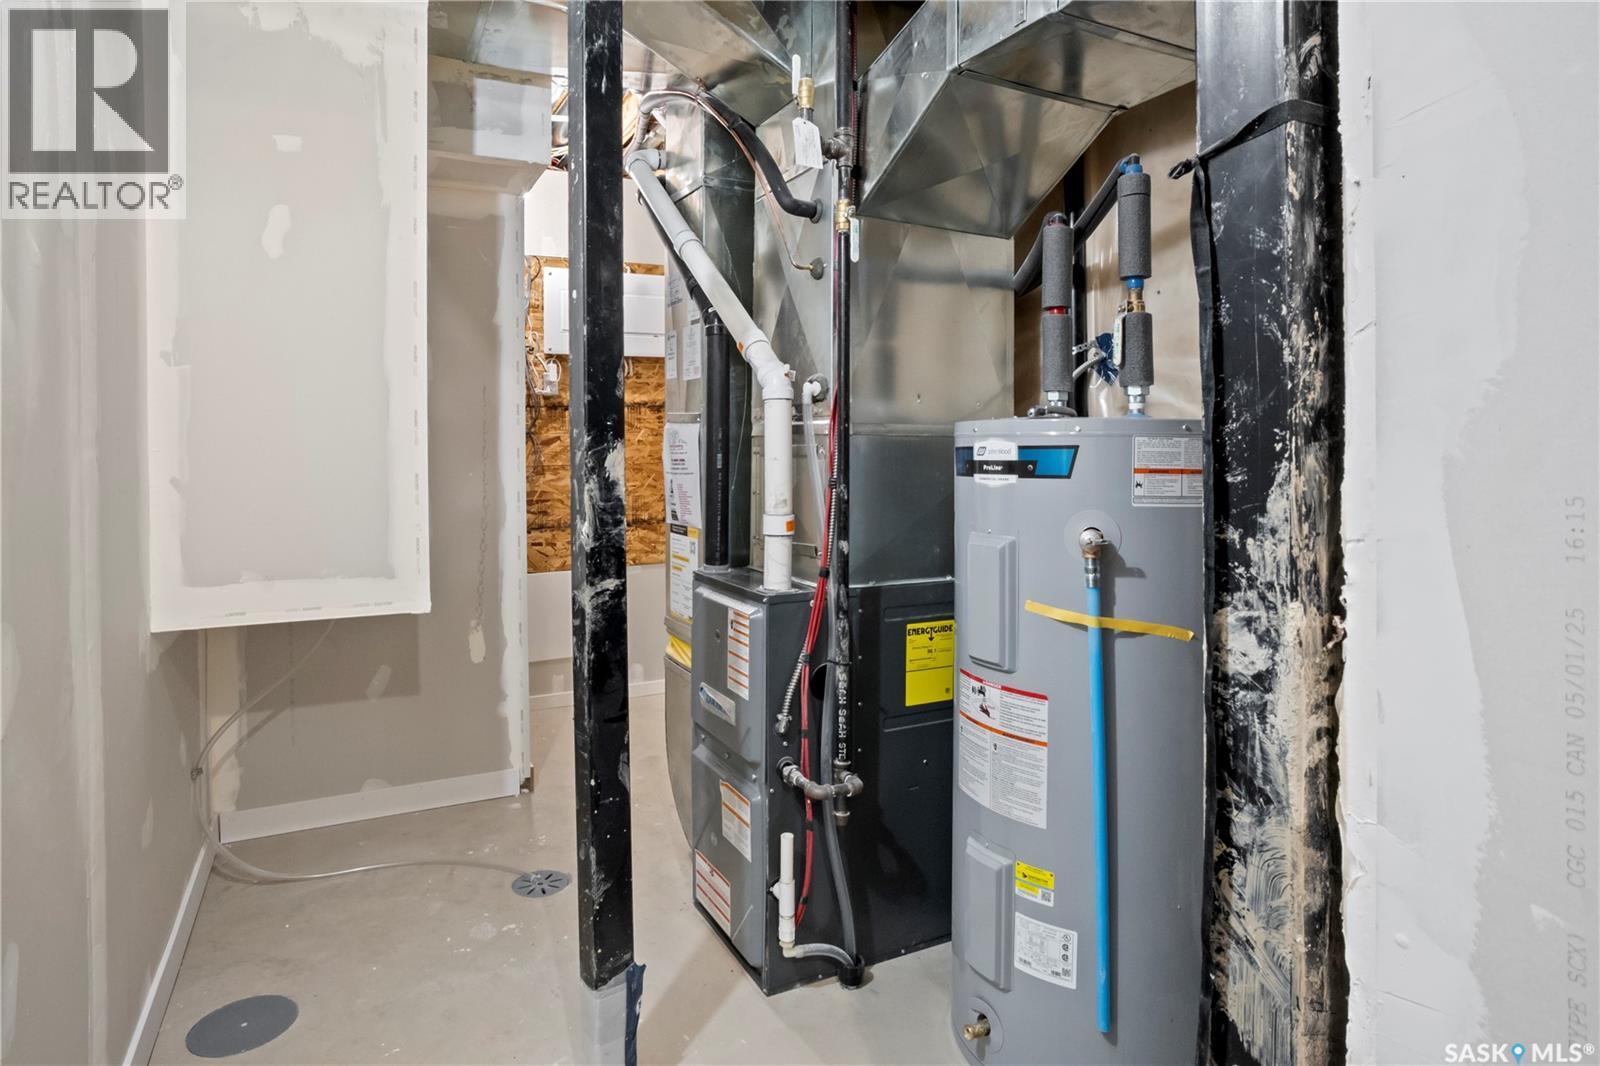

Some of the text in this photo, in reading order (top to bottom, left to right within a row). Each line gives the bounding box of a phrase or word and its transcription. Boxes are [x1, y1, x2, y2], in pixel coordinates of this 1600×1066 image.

[1565, 496, 1585, 562] 16:15
[1565, 608, 1585, 718] 05/01/25
[1566, 732, 1585, 776] CAN
[1565, 790, 1586, 831] 015
[1566, 845, 1586, 889] CGC
